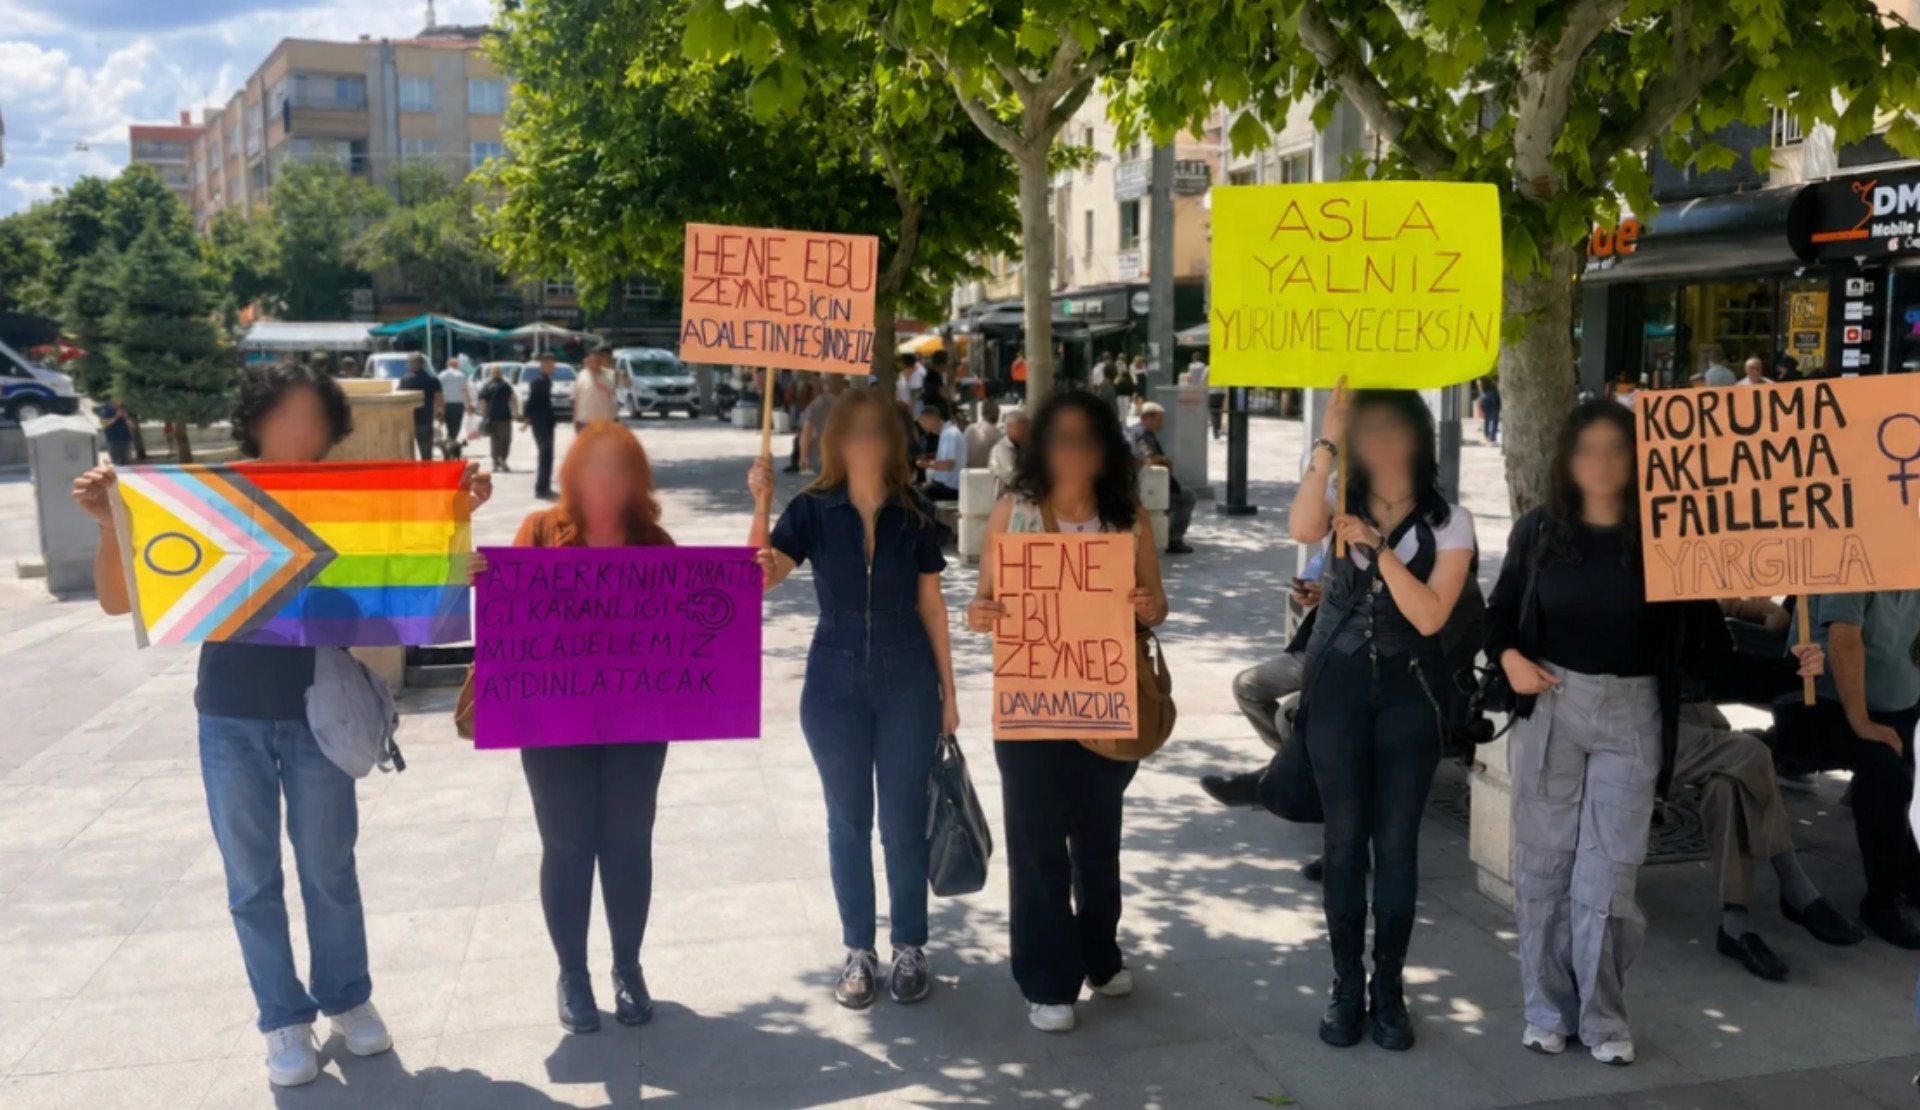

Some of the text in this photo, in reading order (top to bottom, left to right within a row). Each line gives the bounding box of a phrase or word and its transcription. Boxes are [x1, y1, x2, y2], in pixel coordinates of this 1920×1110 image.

[1269, 198, 1440, 242] ASLA
[1874, 182, 1920, 216] DM
[1871, 221, 1914, 239] Mobile
[694, 233, 873, 292] HENE EBU
[1253, 251, 1462, 294] YALNIZ
[689, 275, 806, 316] ZEYNEB
[1642, 382, 1847, 441] KORUMA
[1645, 433, 1840, 491] AKLAMA
[1651, 478, 1854, 538] FAİLLERİ
[999, 541, 1113, 593] HENE
[1655, 535, 1877, 596] YARGILA
[996, 592, 1061, 645] EBU
[481, 667, 717, 702] AYDINLATACAK
[994, 638, 1128, 685] ZEYNEB
[1000, 690, 1131, 719] DAVAMIZDIR
